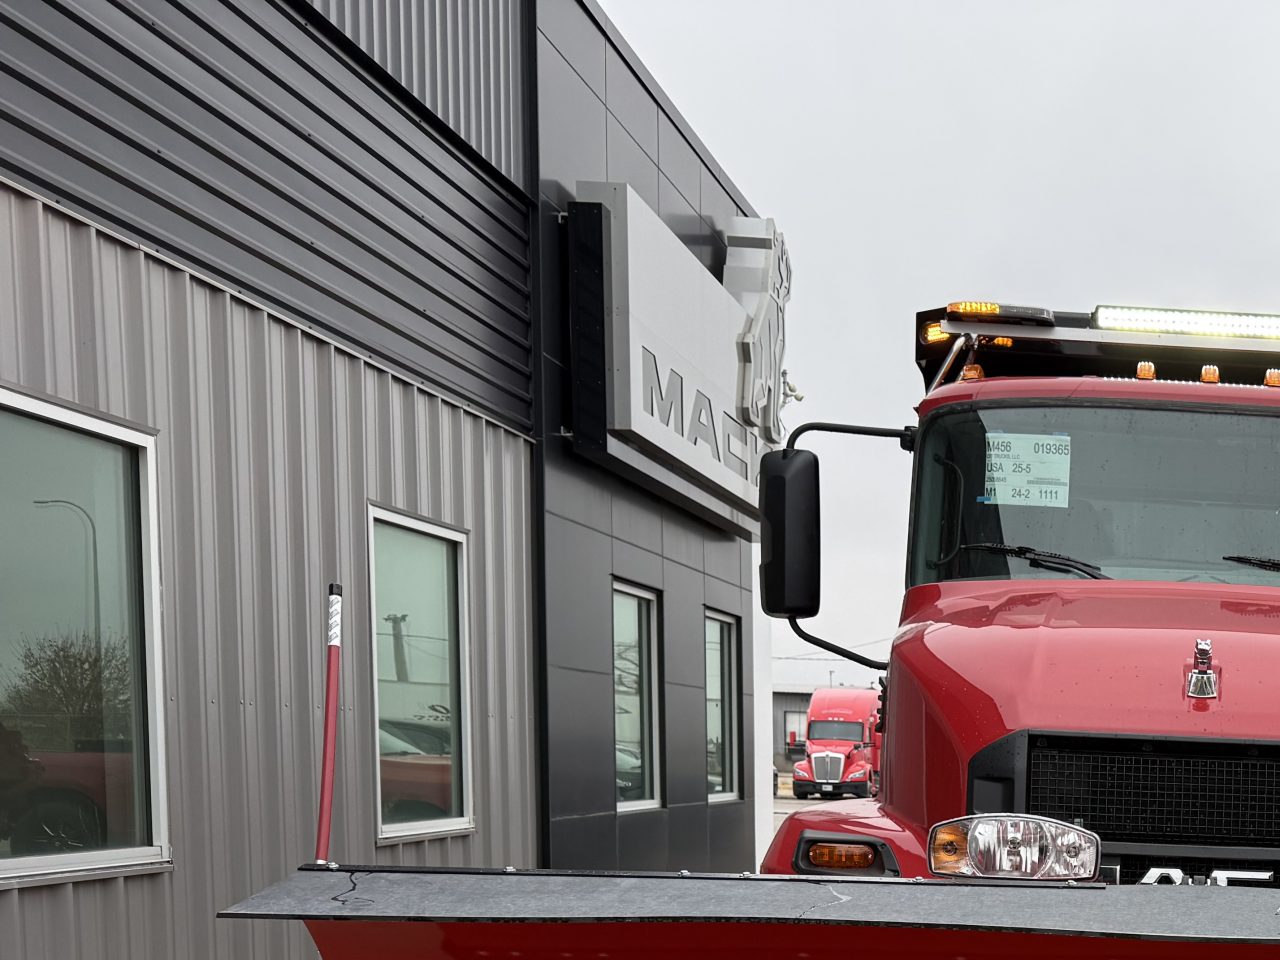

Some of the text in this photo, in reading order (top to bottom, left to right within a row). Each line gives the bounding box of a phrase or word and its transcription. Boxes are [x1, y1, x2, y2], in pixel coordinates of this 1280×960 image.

[987, 441, 1070, 456] M456 019365
[987, 462, 1031, 474] USA 25-5
[1011, 488, 1031, 499] 24-2
[1039, 489, 1058, 500] 1111
